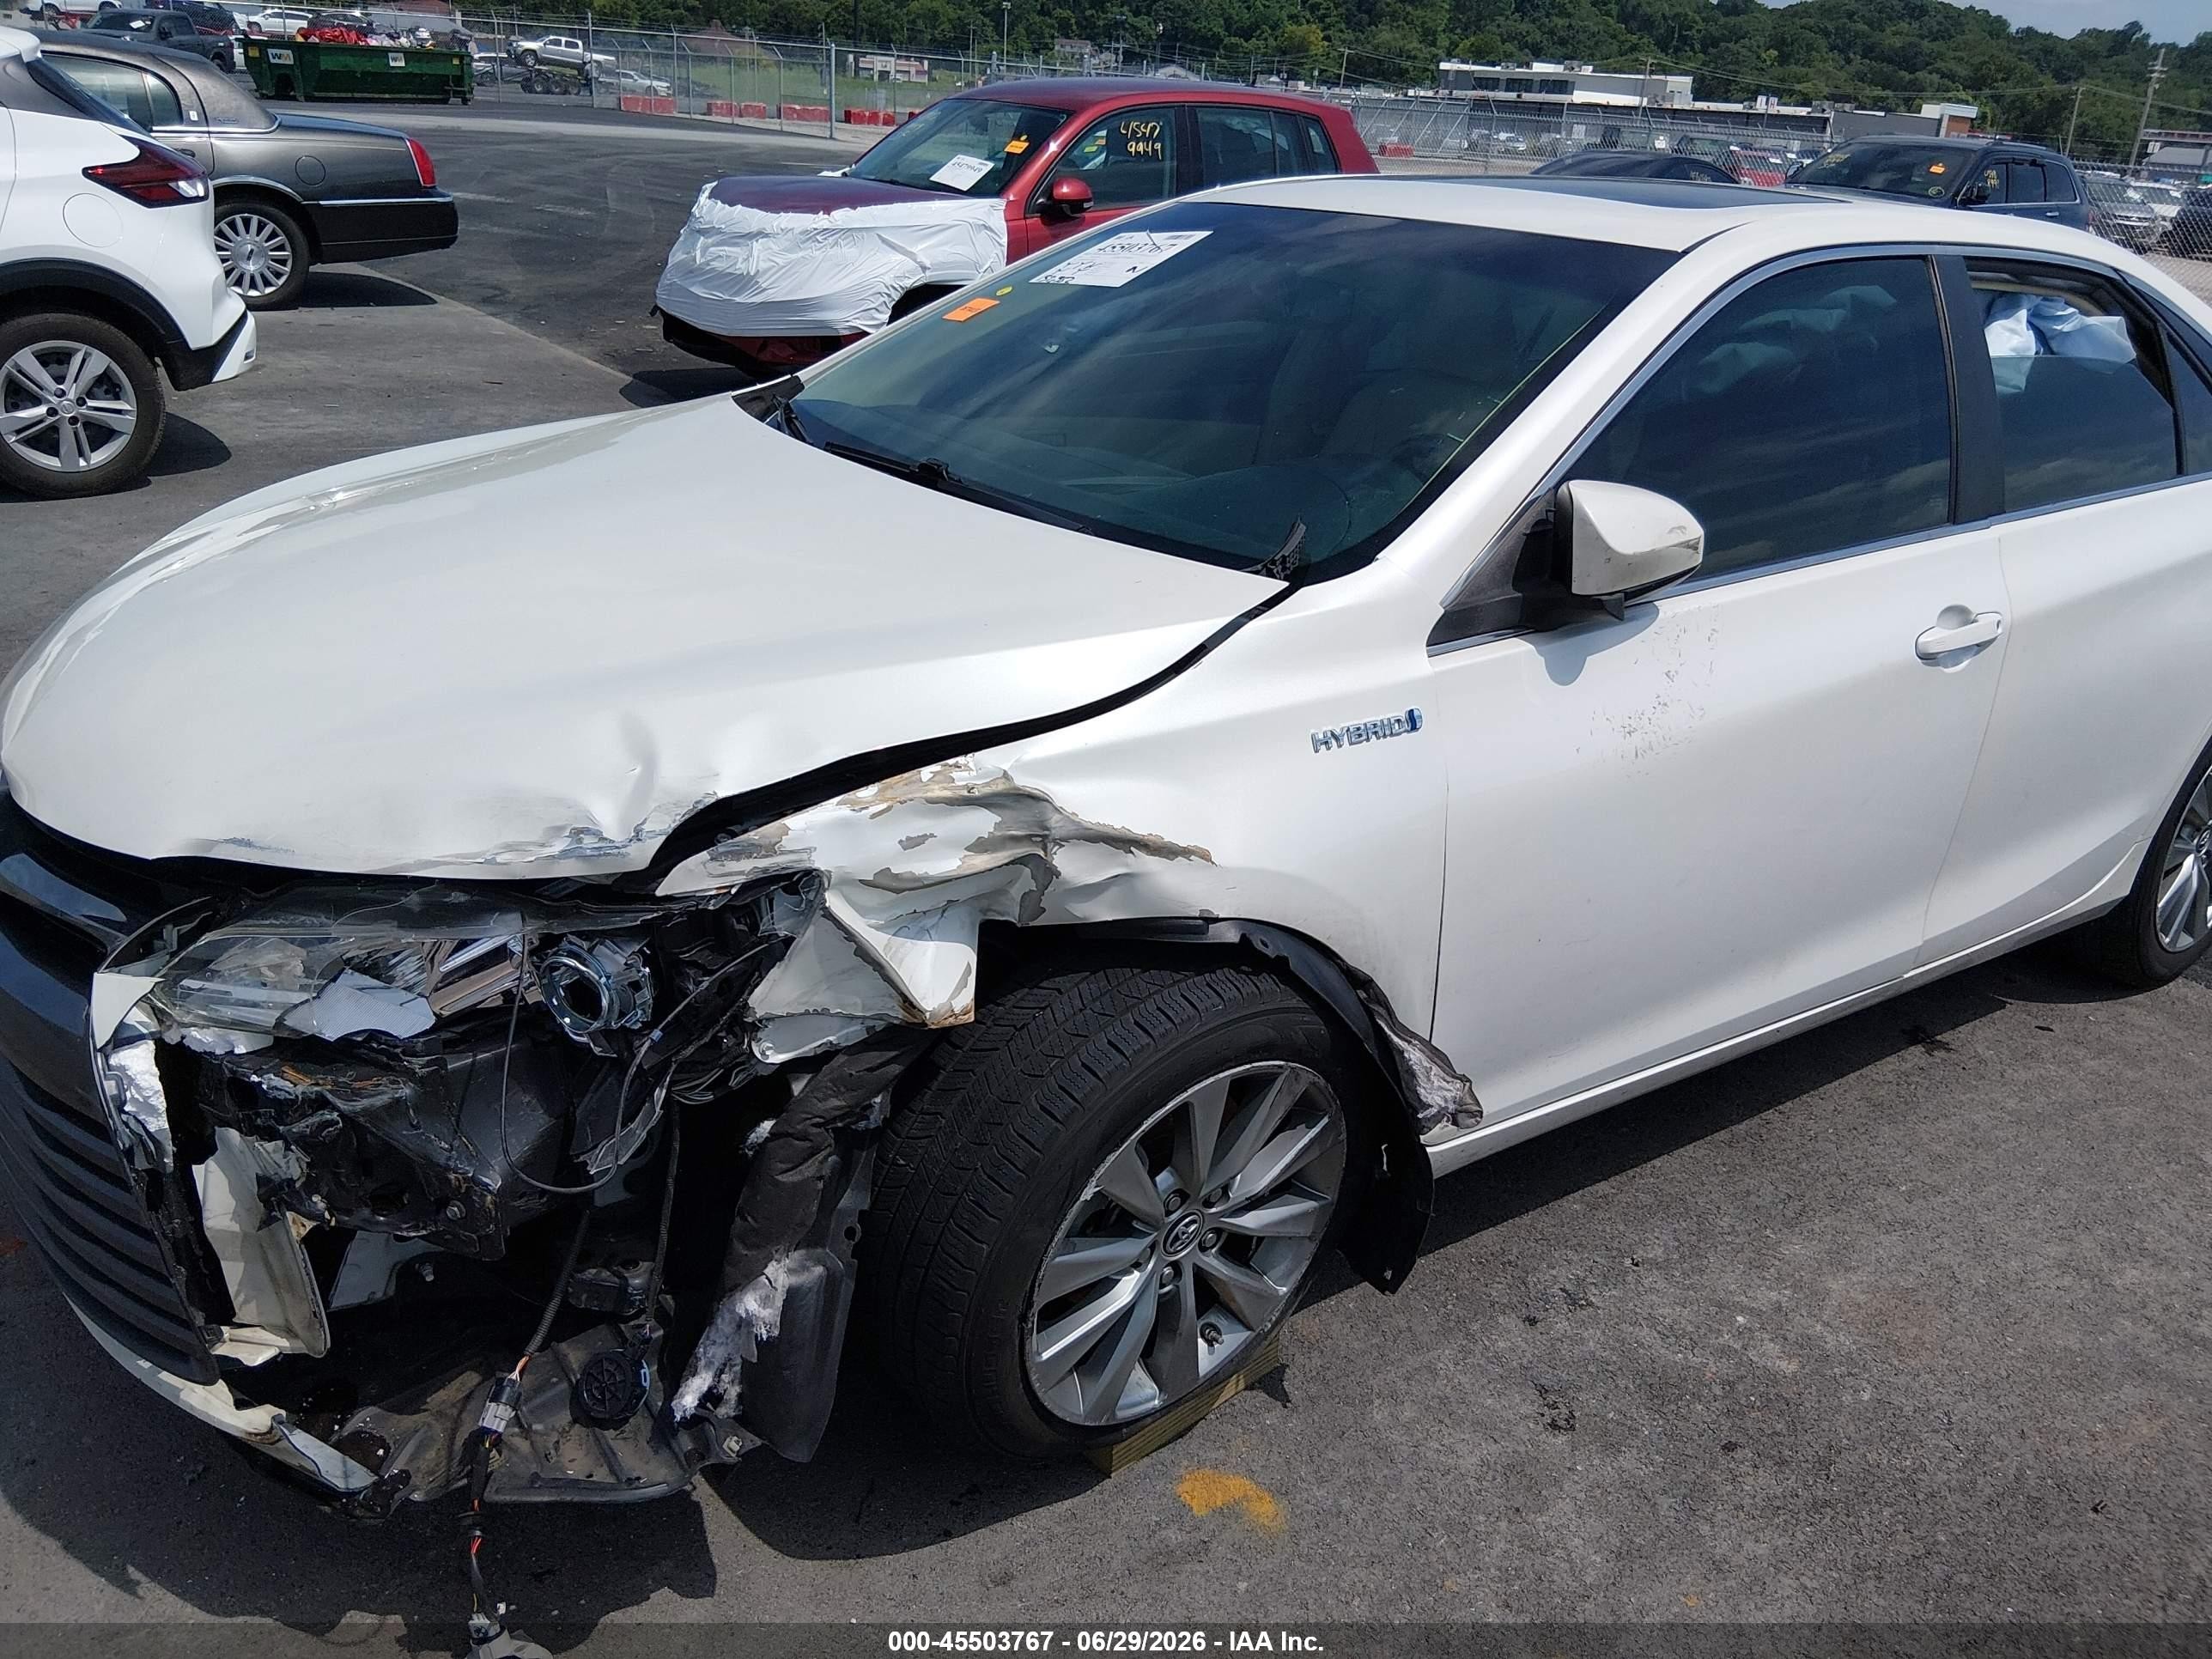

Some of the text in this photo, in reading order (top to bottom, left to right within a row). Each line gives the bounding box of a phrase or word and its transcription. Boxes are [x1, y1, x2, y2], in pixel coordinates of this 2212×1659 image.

[270, 52, 292, 63] WM
[1127, 140, 1162, 161] 9949
[1310, 714, 1408, 753] HYBRID
